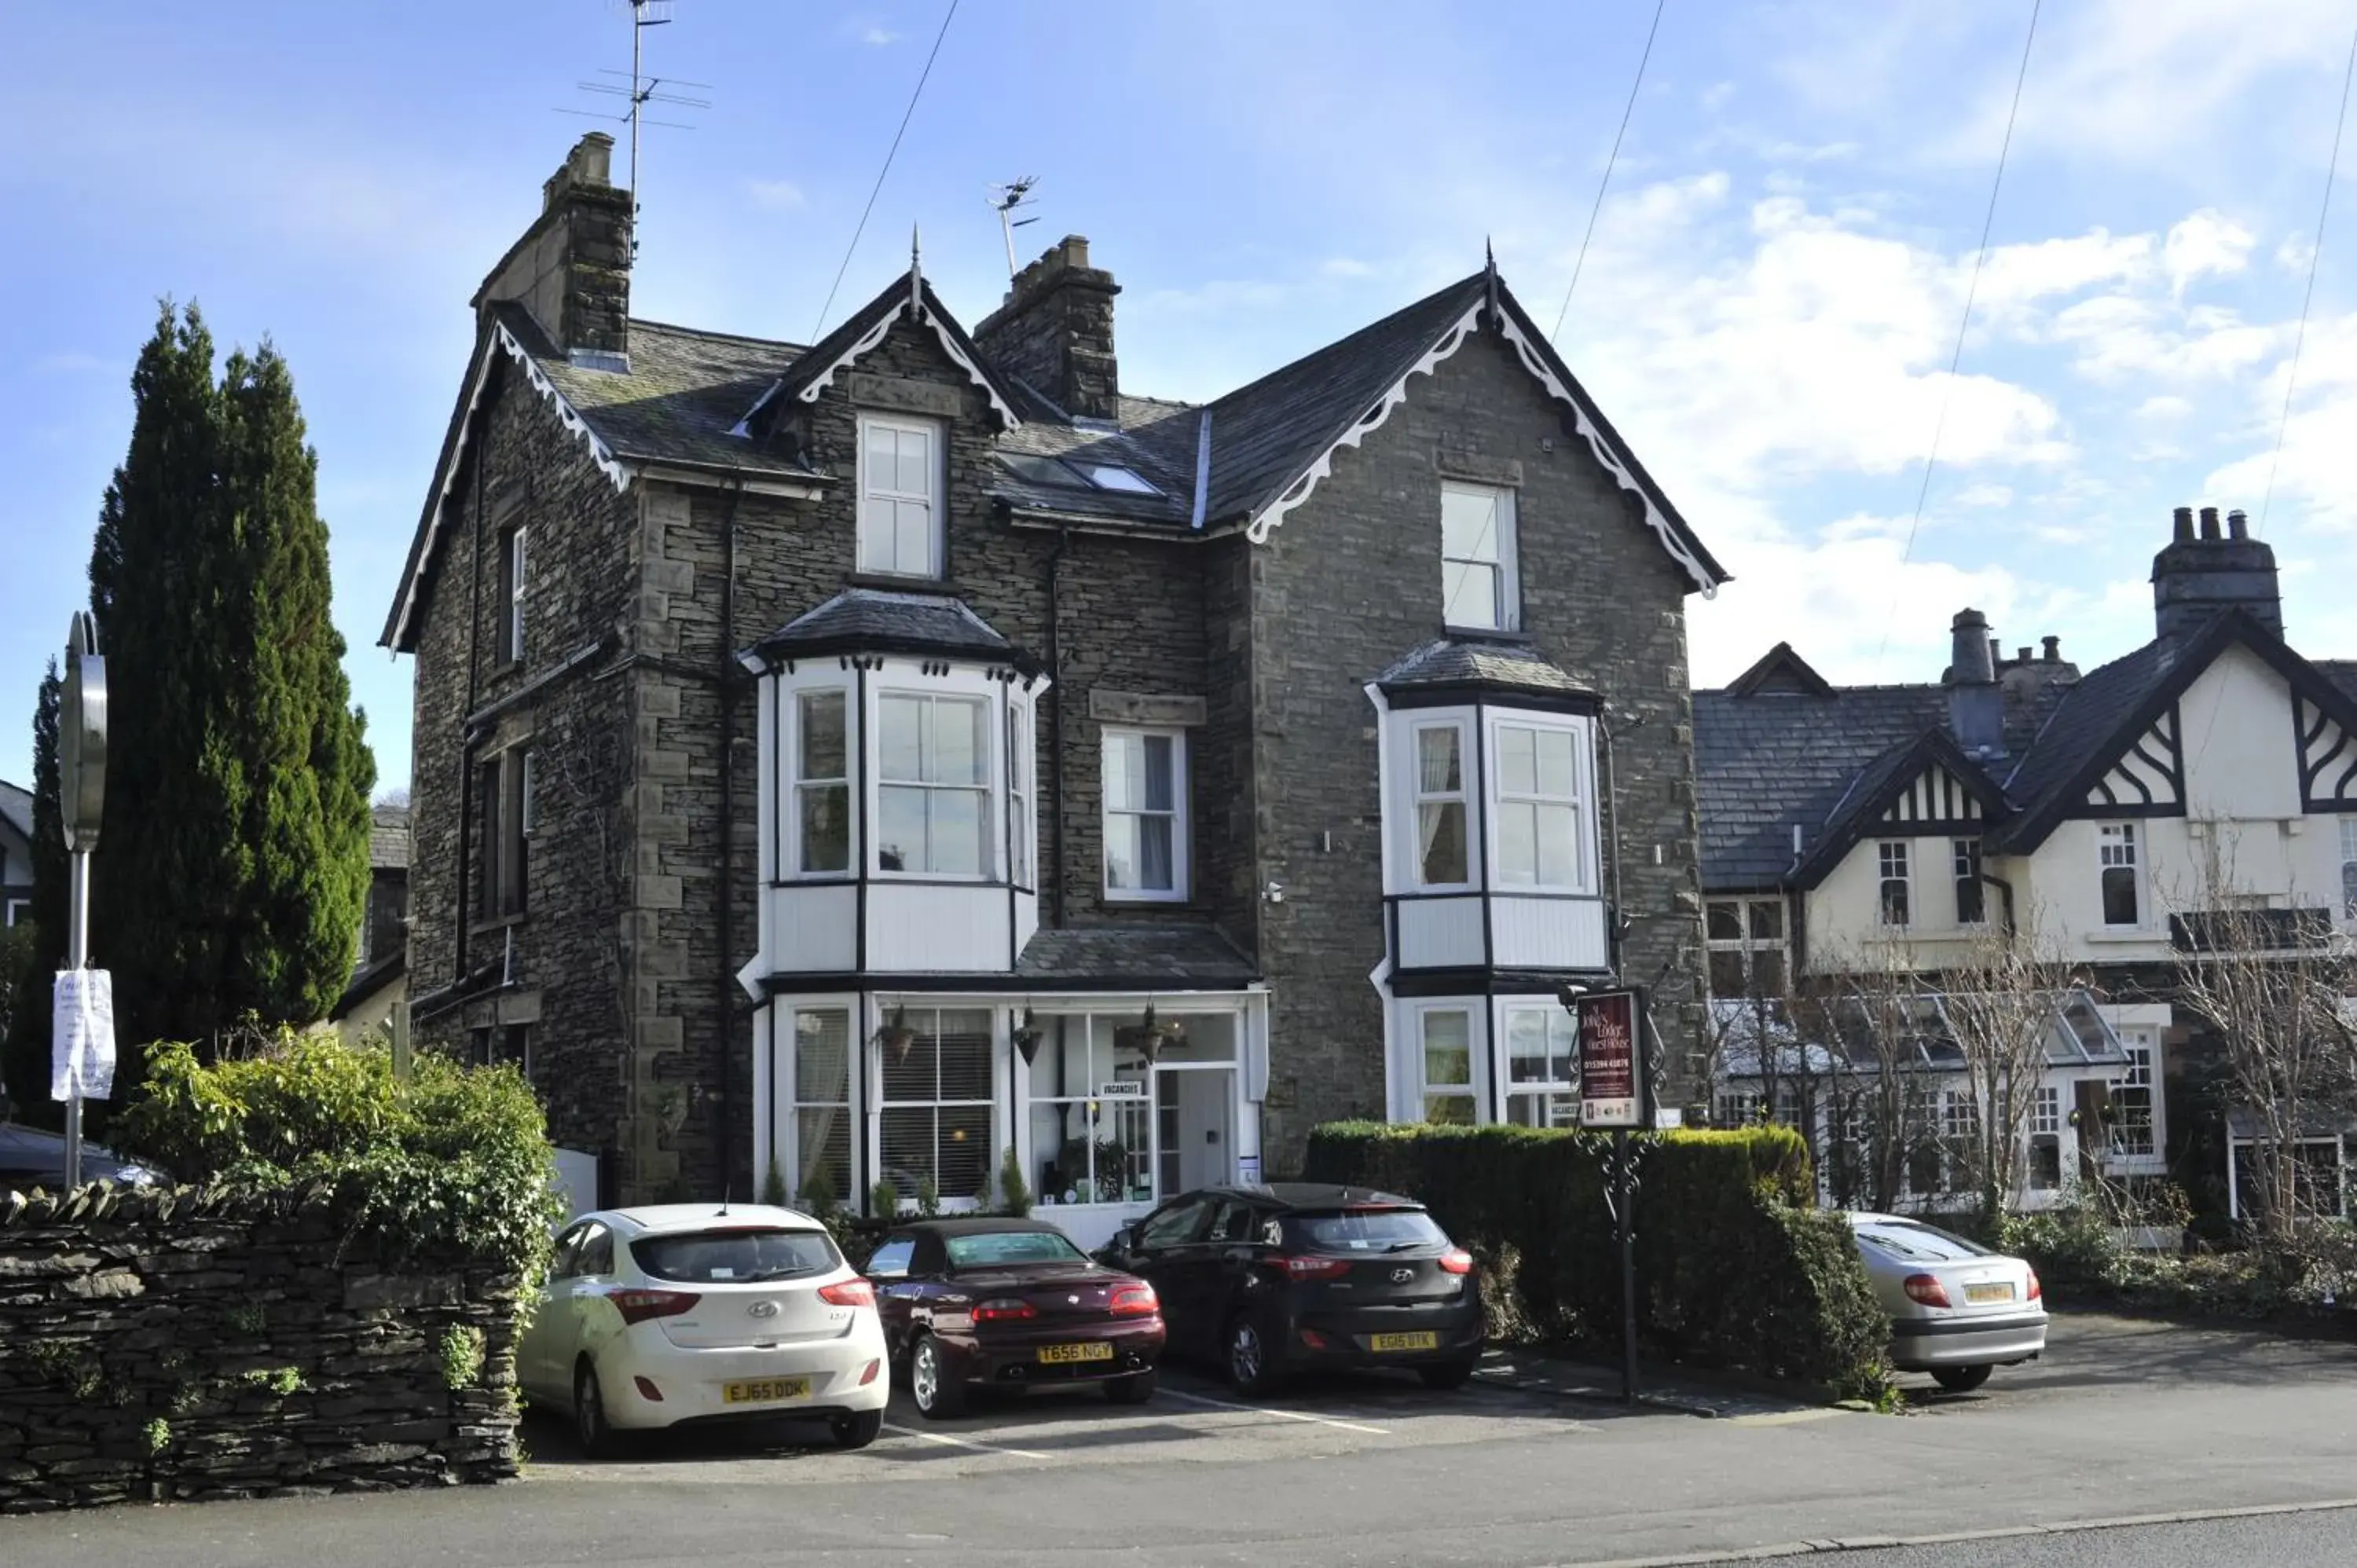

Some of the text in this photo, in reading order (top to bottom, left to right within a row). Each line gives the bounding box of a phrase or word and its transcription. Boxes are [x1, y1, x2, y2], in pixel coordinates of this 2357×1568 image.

[1043, 1343, 1109, 1361] T656 NGY
[731, 1383, 770, 1401] EJ65
